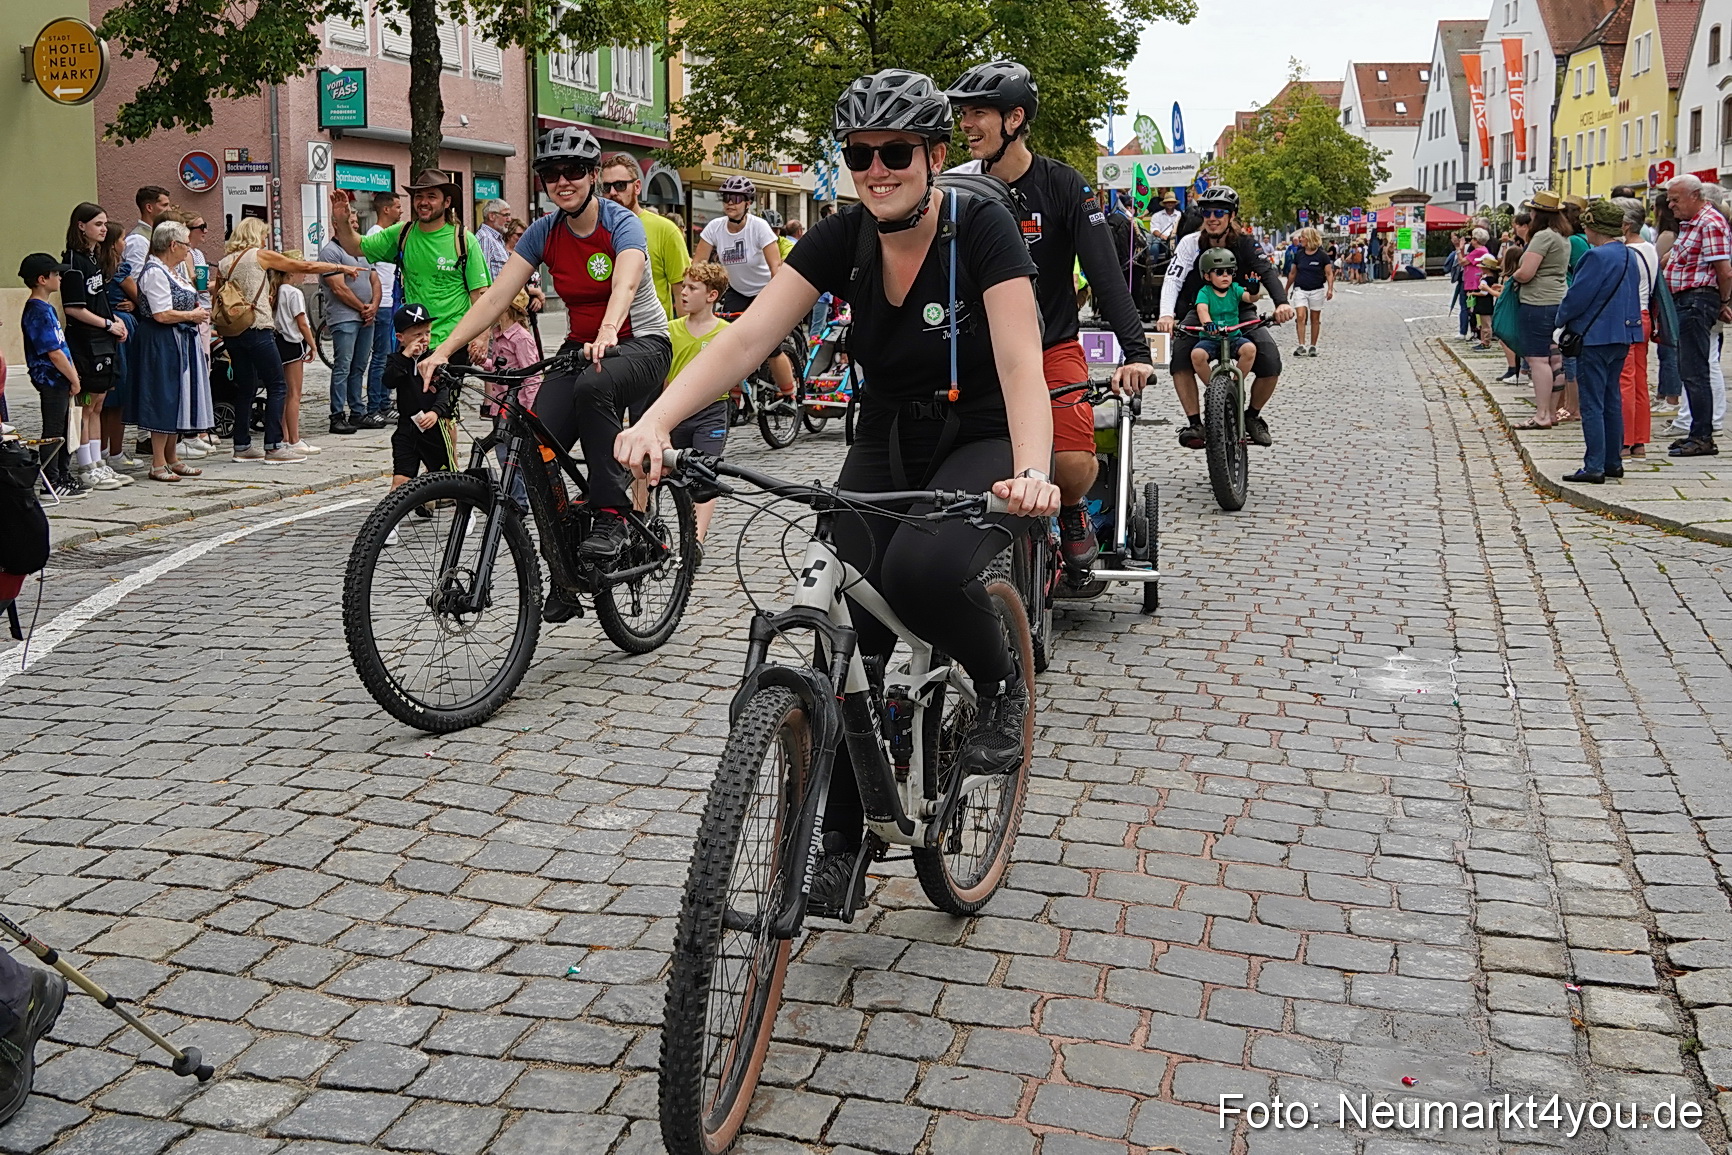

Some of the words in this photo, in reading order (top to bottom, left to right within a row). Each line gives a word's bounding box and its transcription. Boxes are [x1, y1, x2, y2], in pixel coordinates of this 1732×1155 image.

[49, 43, 94, 55] HOTEL
[49, 56, 77, 68] NEU
[50, 68, 94, 80] MARKT
[326, 79, 344, 91] vom
[332, 82, 358, 99] FASS
[1507, 70, 1525, 121] SALE
[1579, 111, 1595, 127] HOTEL
[226, 162, 269, 173] Bockwirtsgasse
[335, 170, 367, 185] Spirituosen
[369, 173, 391, 188] Whisky
[228, 188, 248, 196] Venezia
[942, 328, 961, 340] Jua
[384, 675, 425, 714] MAXXIS
